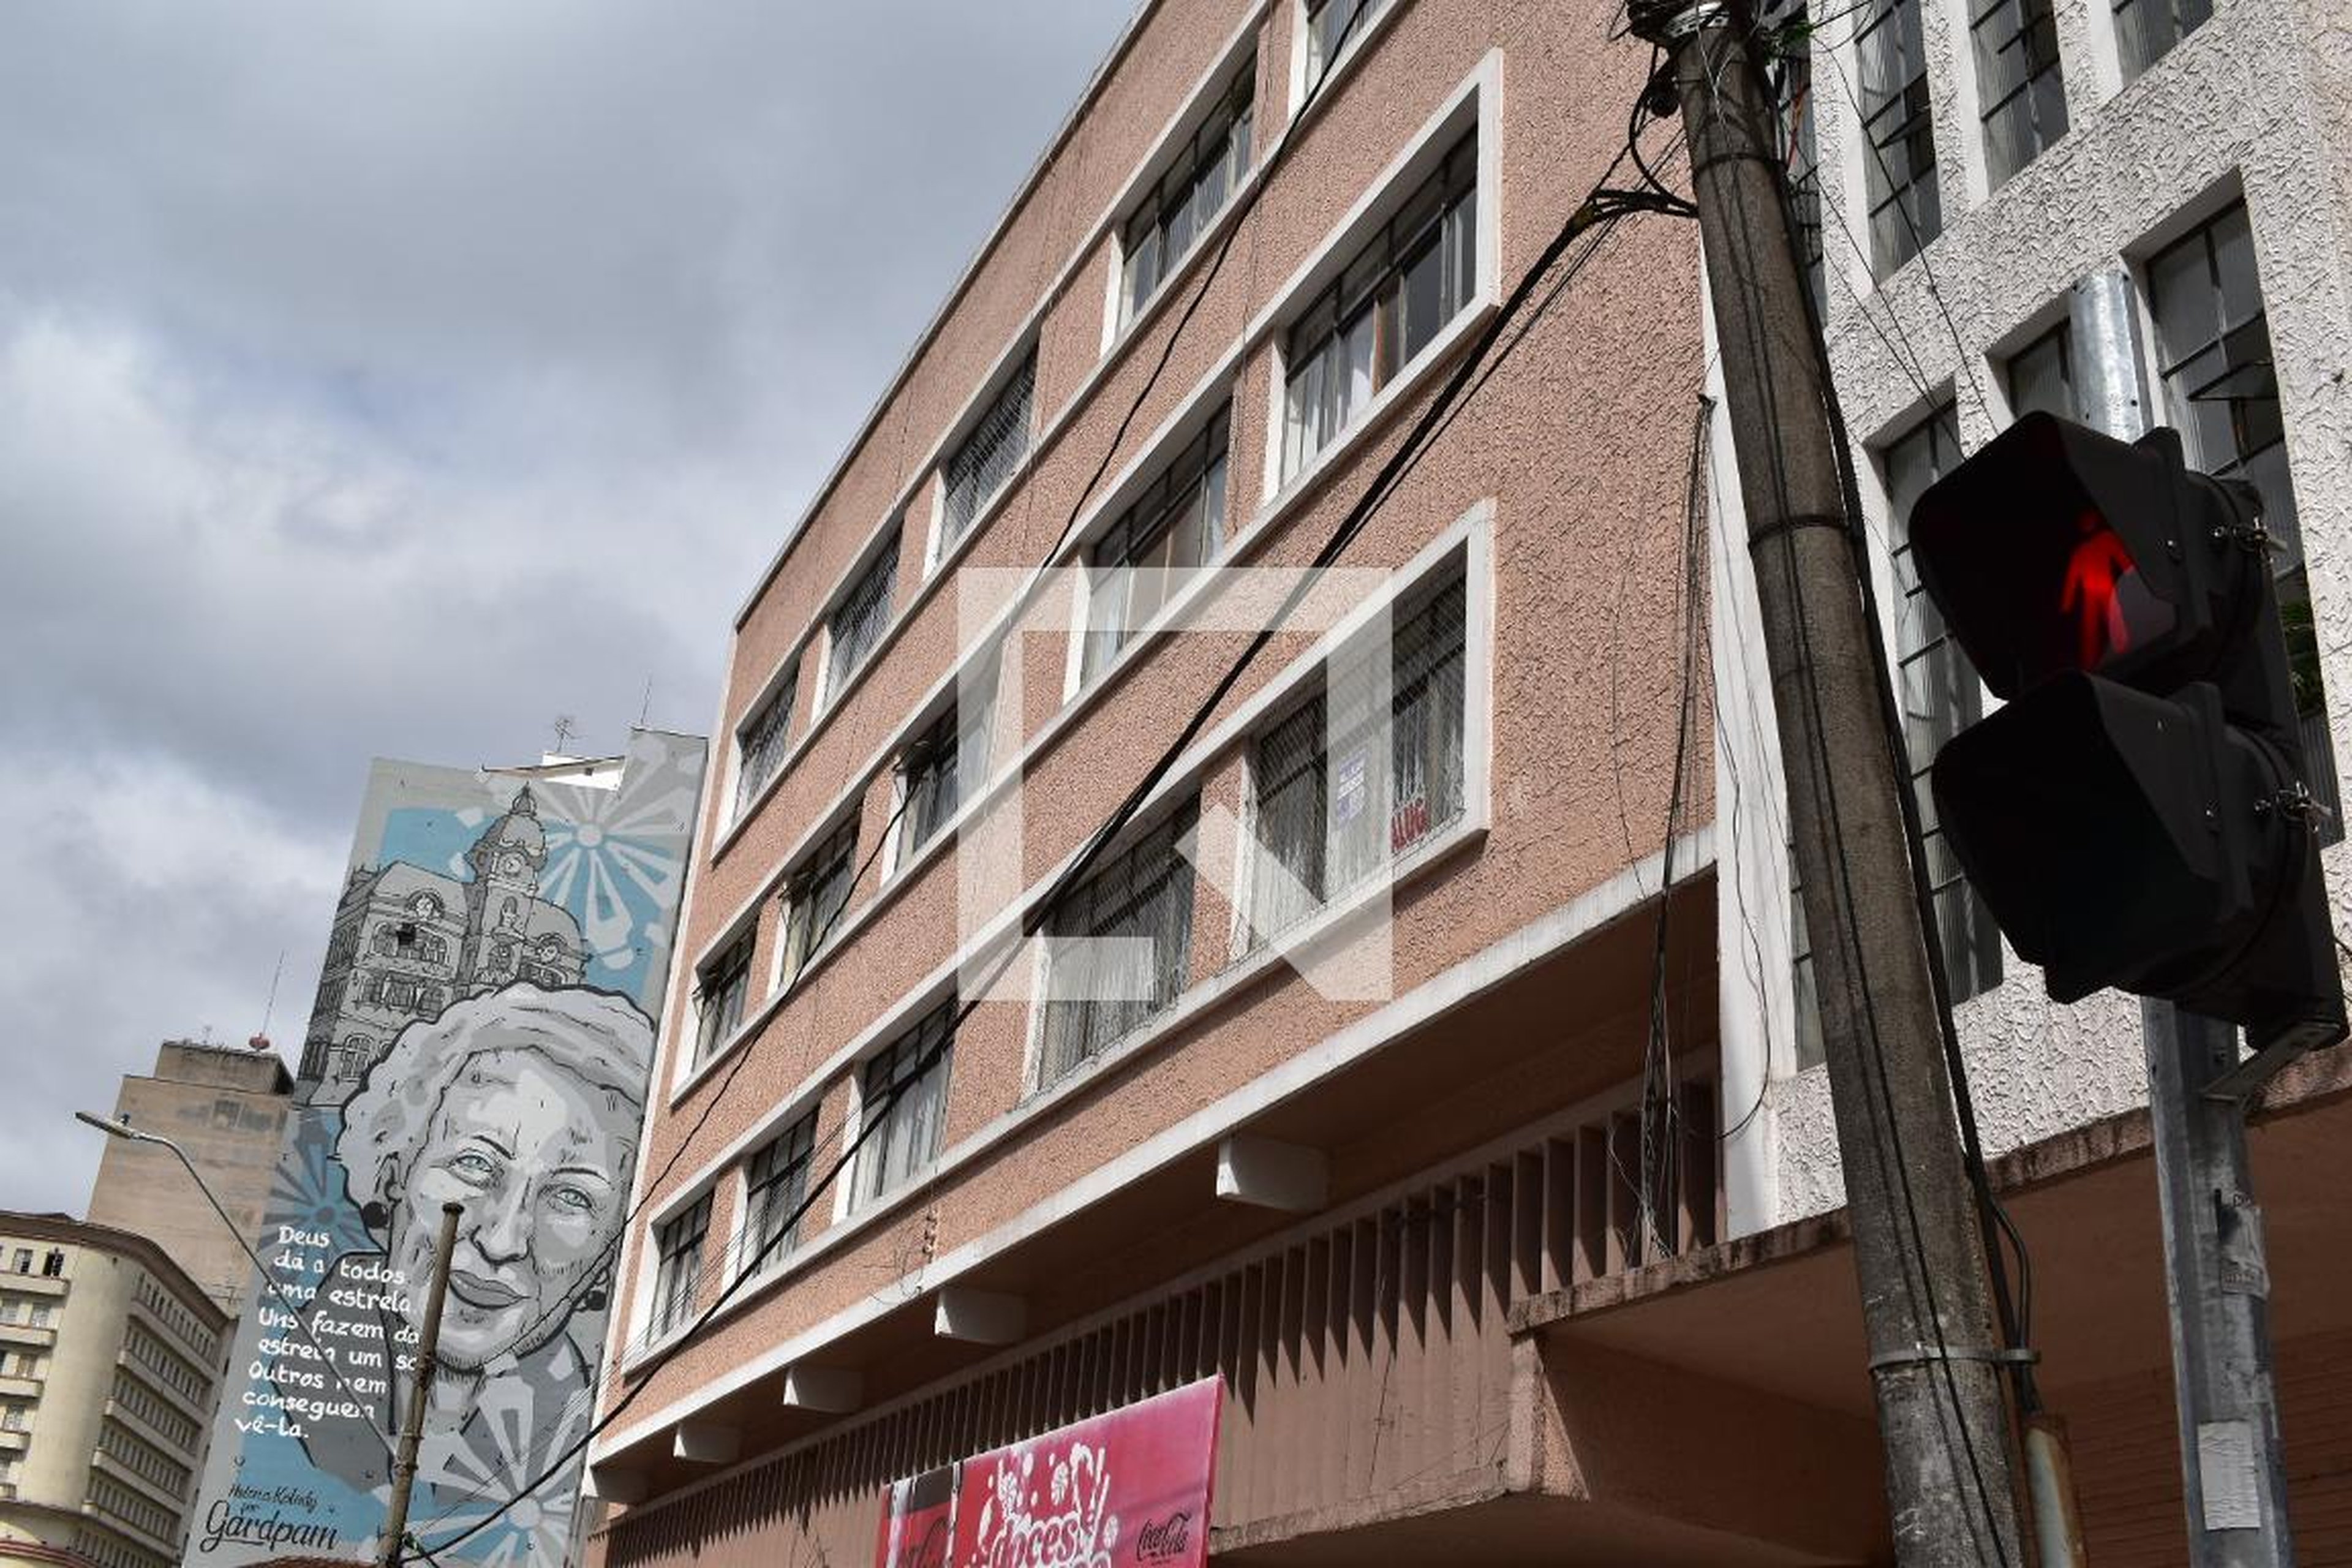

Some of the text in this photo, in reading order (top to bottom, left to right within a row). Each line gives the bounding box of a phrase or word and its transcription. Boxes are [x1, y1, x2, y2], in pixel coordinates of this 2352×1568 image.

[279, 1226, 330, 1248] Deus
[314, 1259, 325, 1273] a
[341, 1259, 405, 1284] todos
[258, 1306, 299, 1329] Uns
[311, 1310, 385, 1340] fazem
[349, 1351, 382, 1368] um
[249, 1360, 324, 1389] Outros
[235, 1415, 309, 1438] vê-la.
